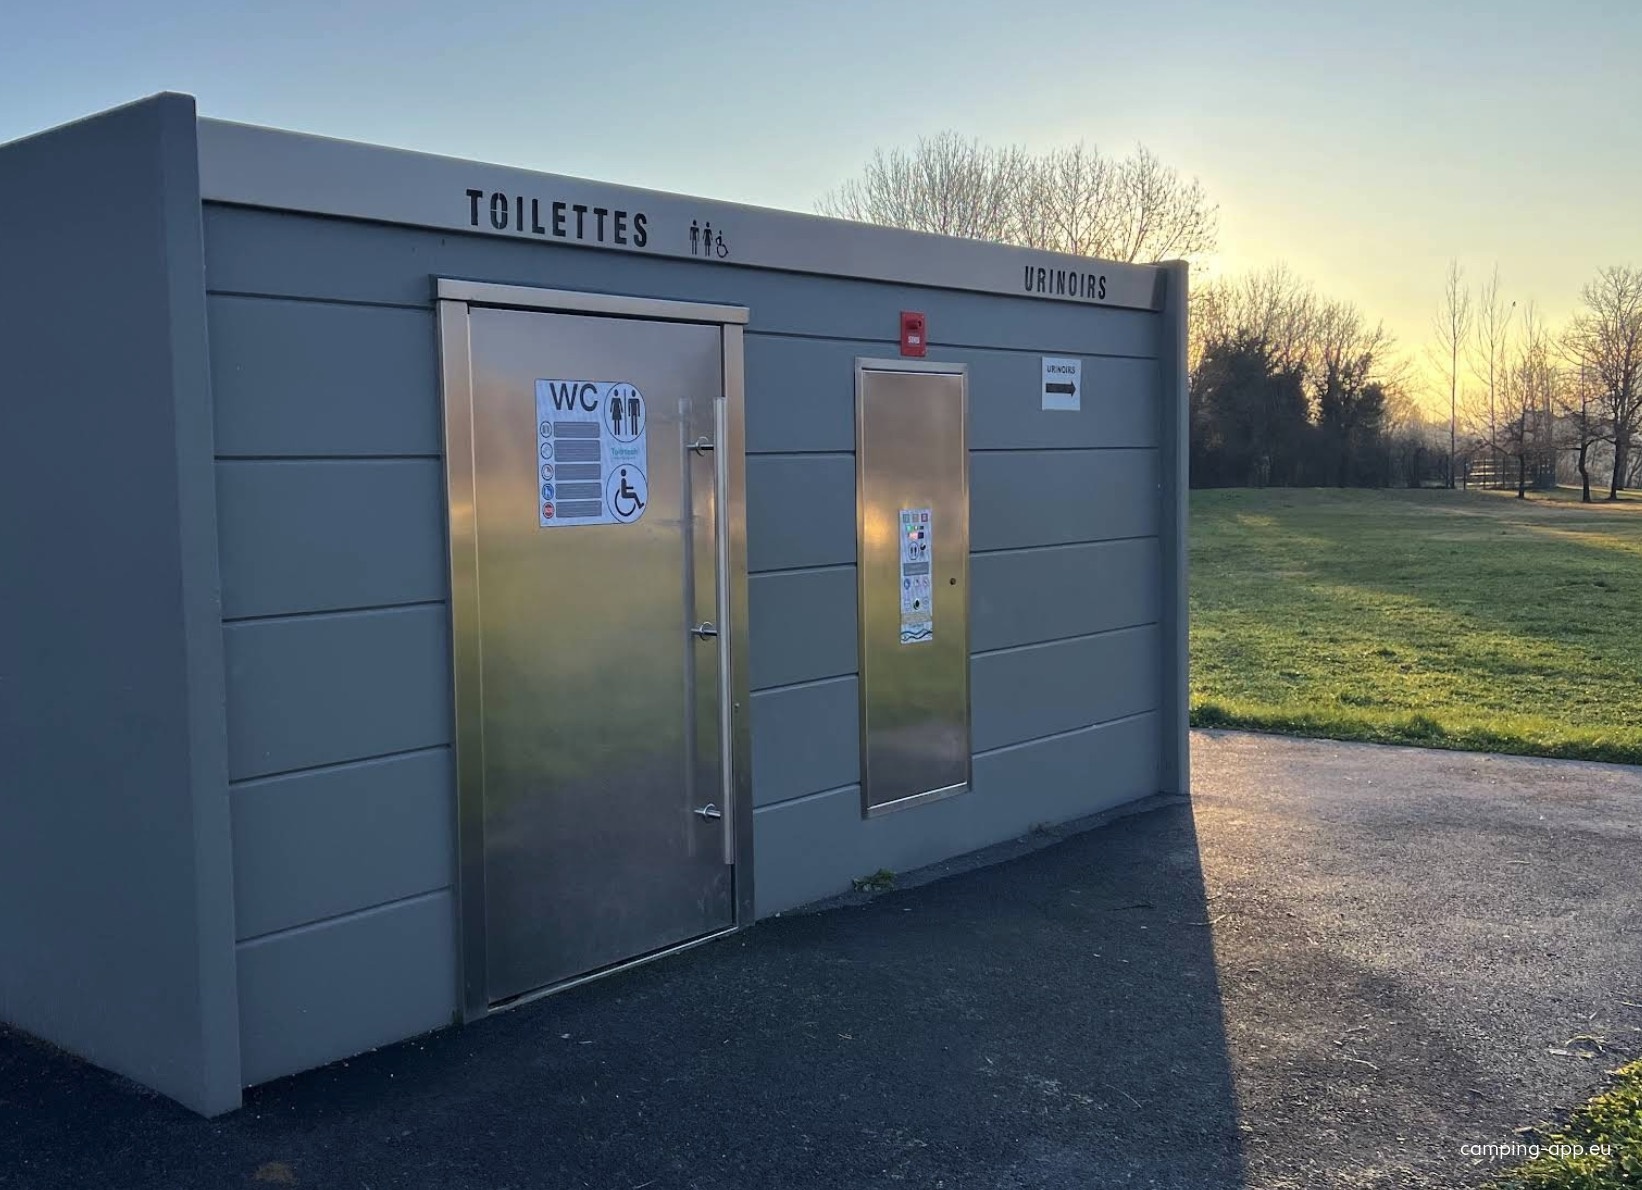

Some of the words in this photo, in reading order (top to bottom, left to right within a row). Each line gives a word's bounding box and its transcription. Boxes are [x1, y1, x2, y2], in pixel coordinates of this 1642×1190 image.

[466, 188, 648, 248] TOILETTES
[1024, 265, 1106, 300] URINOIRS
[1046, 365, 1076, 374] URINOIRS
[550, 382, 598, 412] WC
